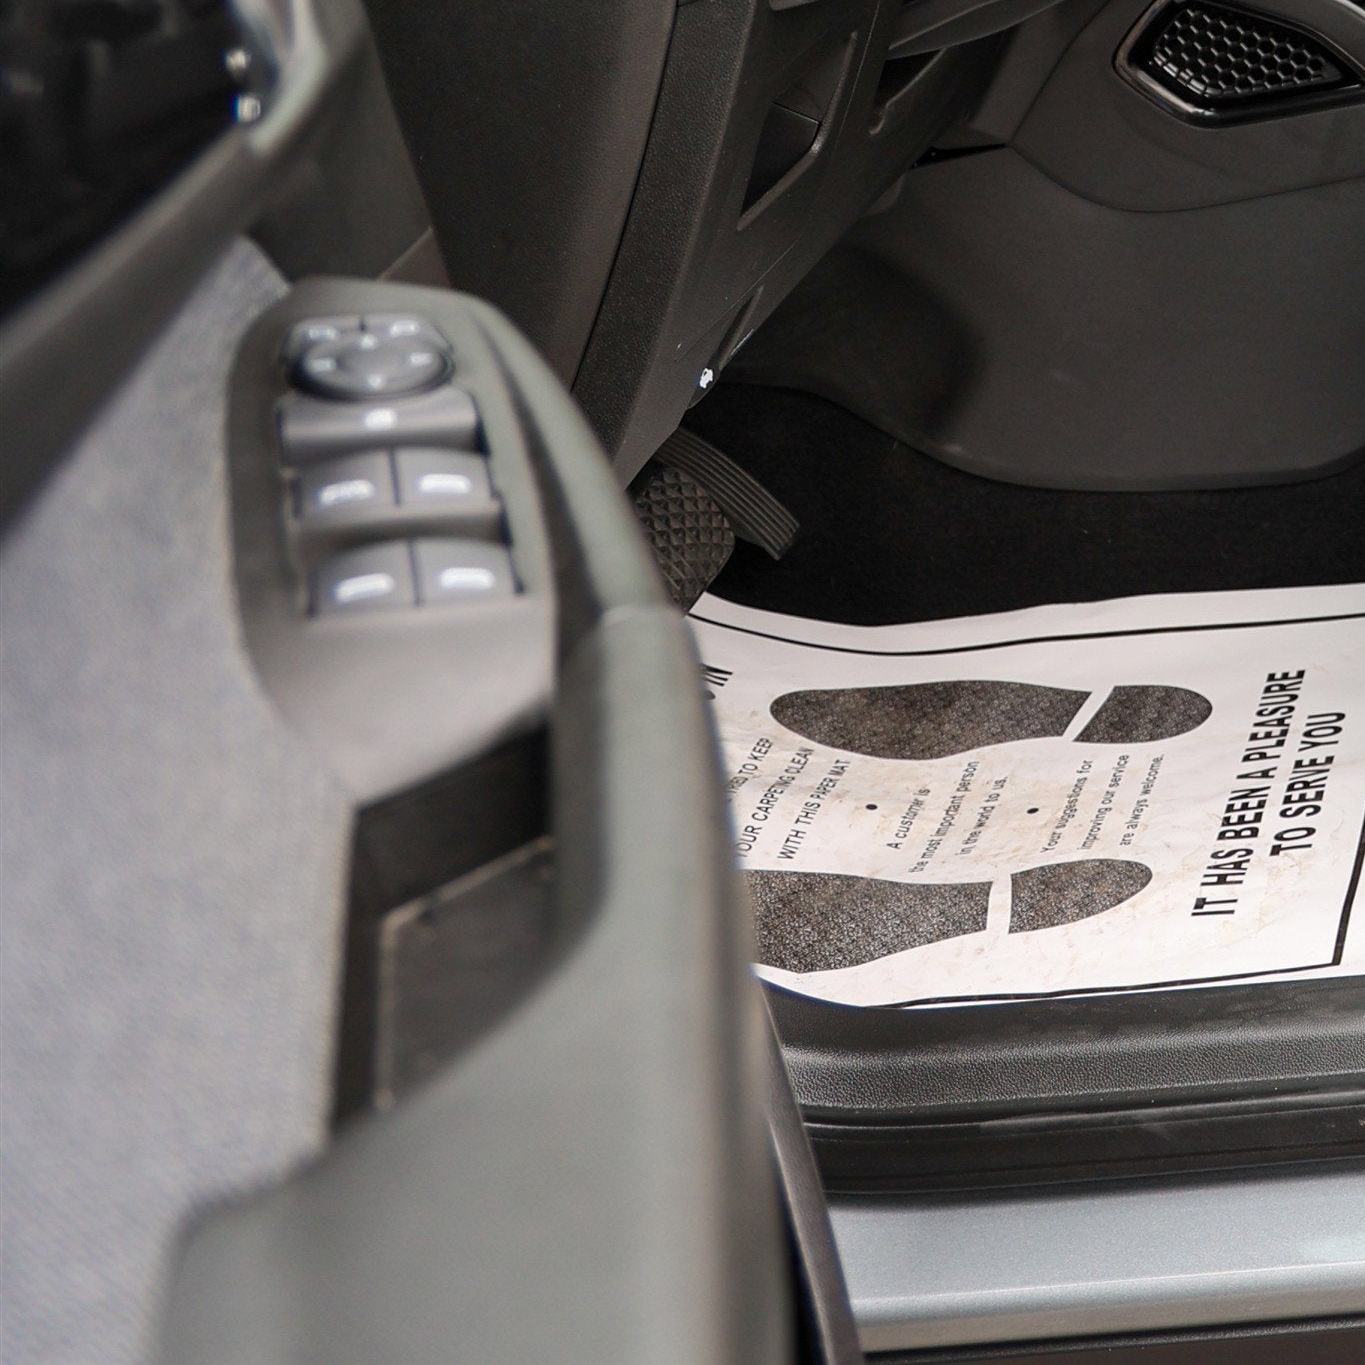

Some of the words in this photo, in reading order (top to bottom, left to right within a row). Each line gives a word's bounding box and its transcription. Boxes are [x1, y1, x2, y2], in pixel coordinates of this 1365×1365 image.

[1242, 670, 1305, 762] PLEASURE
[1298, 713, 1345, 752] YOU
[738, 764, 758, 775] TO
[748, 738, 773, 761] KEEP
[784, 748, 814, 774] CLEAN
[956, 762, 979, 792] person
[993, 777, 1007, 790] us.
[1141, 755, 1163, 795] welcome.
[1237, 767, 1277, 779] A
[1279, 756, 1334, 818] SERVE
[778, 830, 806, 859] WITH
[795, 802, 821, 824] THIS
[810, 778, 838, 799] PAPER
[828, 760, 850, 776] MAT
[985, 793, 1000, 802] to
[1041, 832, 1062, 852] Your
[1055, 777, 1087, 829] suggestions
[1076, 760, 1092, 774] for
[1077, 807, 1112, 849] improving
[1101, 791, 1115, 804] our
[1109, 755, 1129, 788] service
[895, 798, 924, 838] customer
[930, 795, 965, 836] important
[975, 806, 995, 829] world
[1125, 799, 1149, 829] always
[1217, 786, 1271, 840] BEEN
[921, 839, 942, 858] most
[955, 847, 974, 855] in
[963, 831, 981, 844] the
[1120, 833, 1134, 845] are
[1270, 827, 1316, 856] TO
[909, 861, 928, 873] the
[1201, 848, 1254, 886] HAS
[1191, 898, 1238, 916] IT
